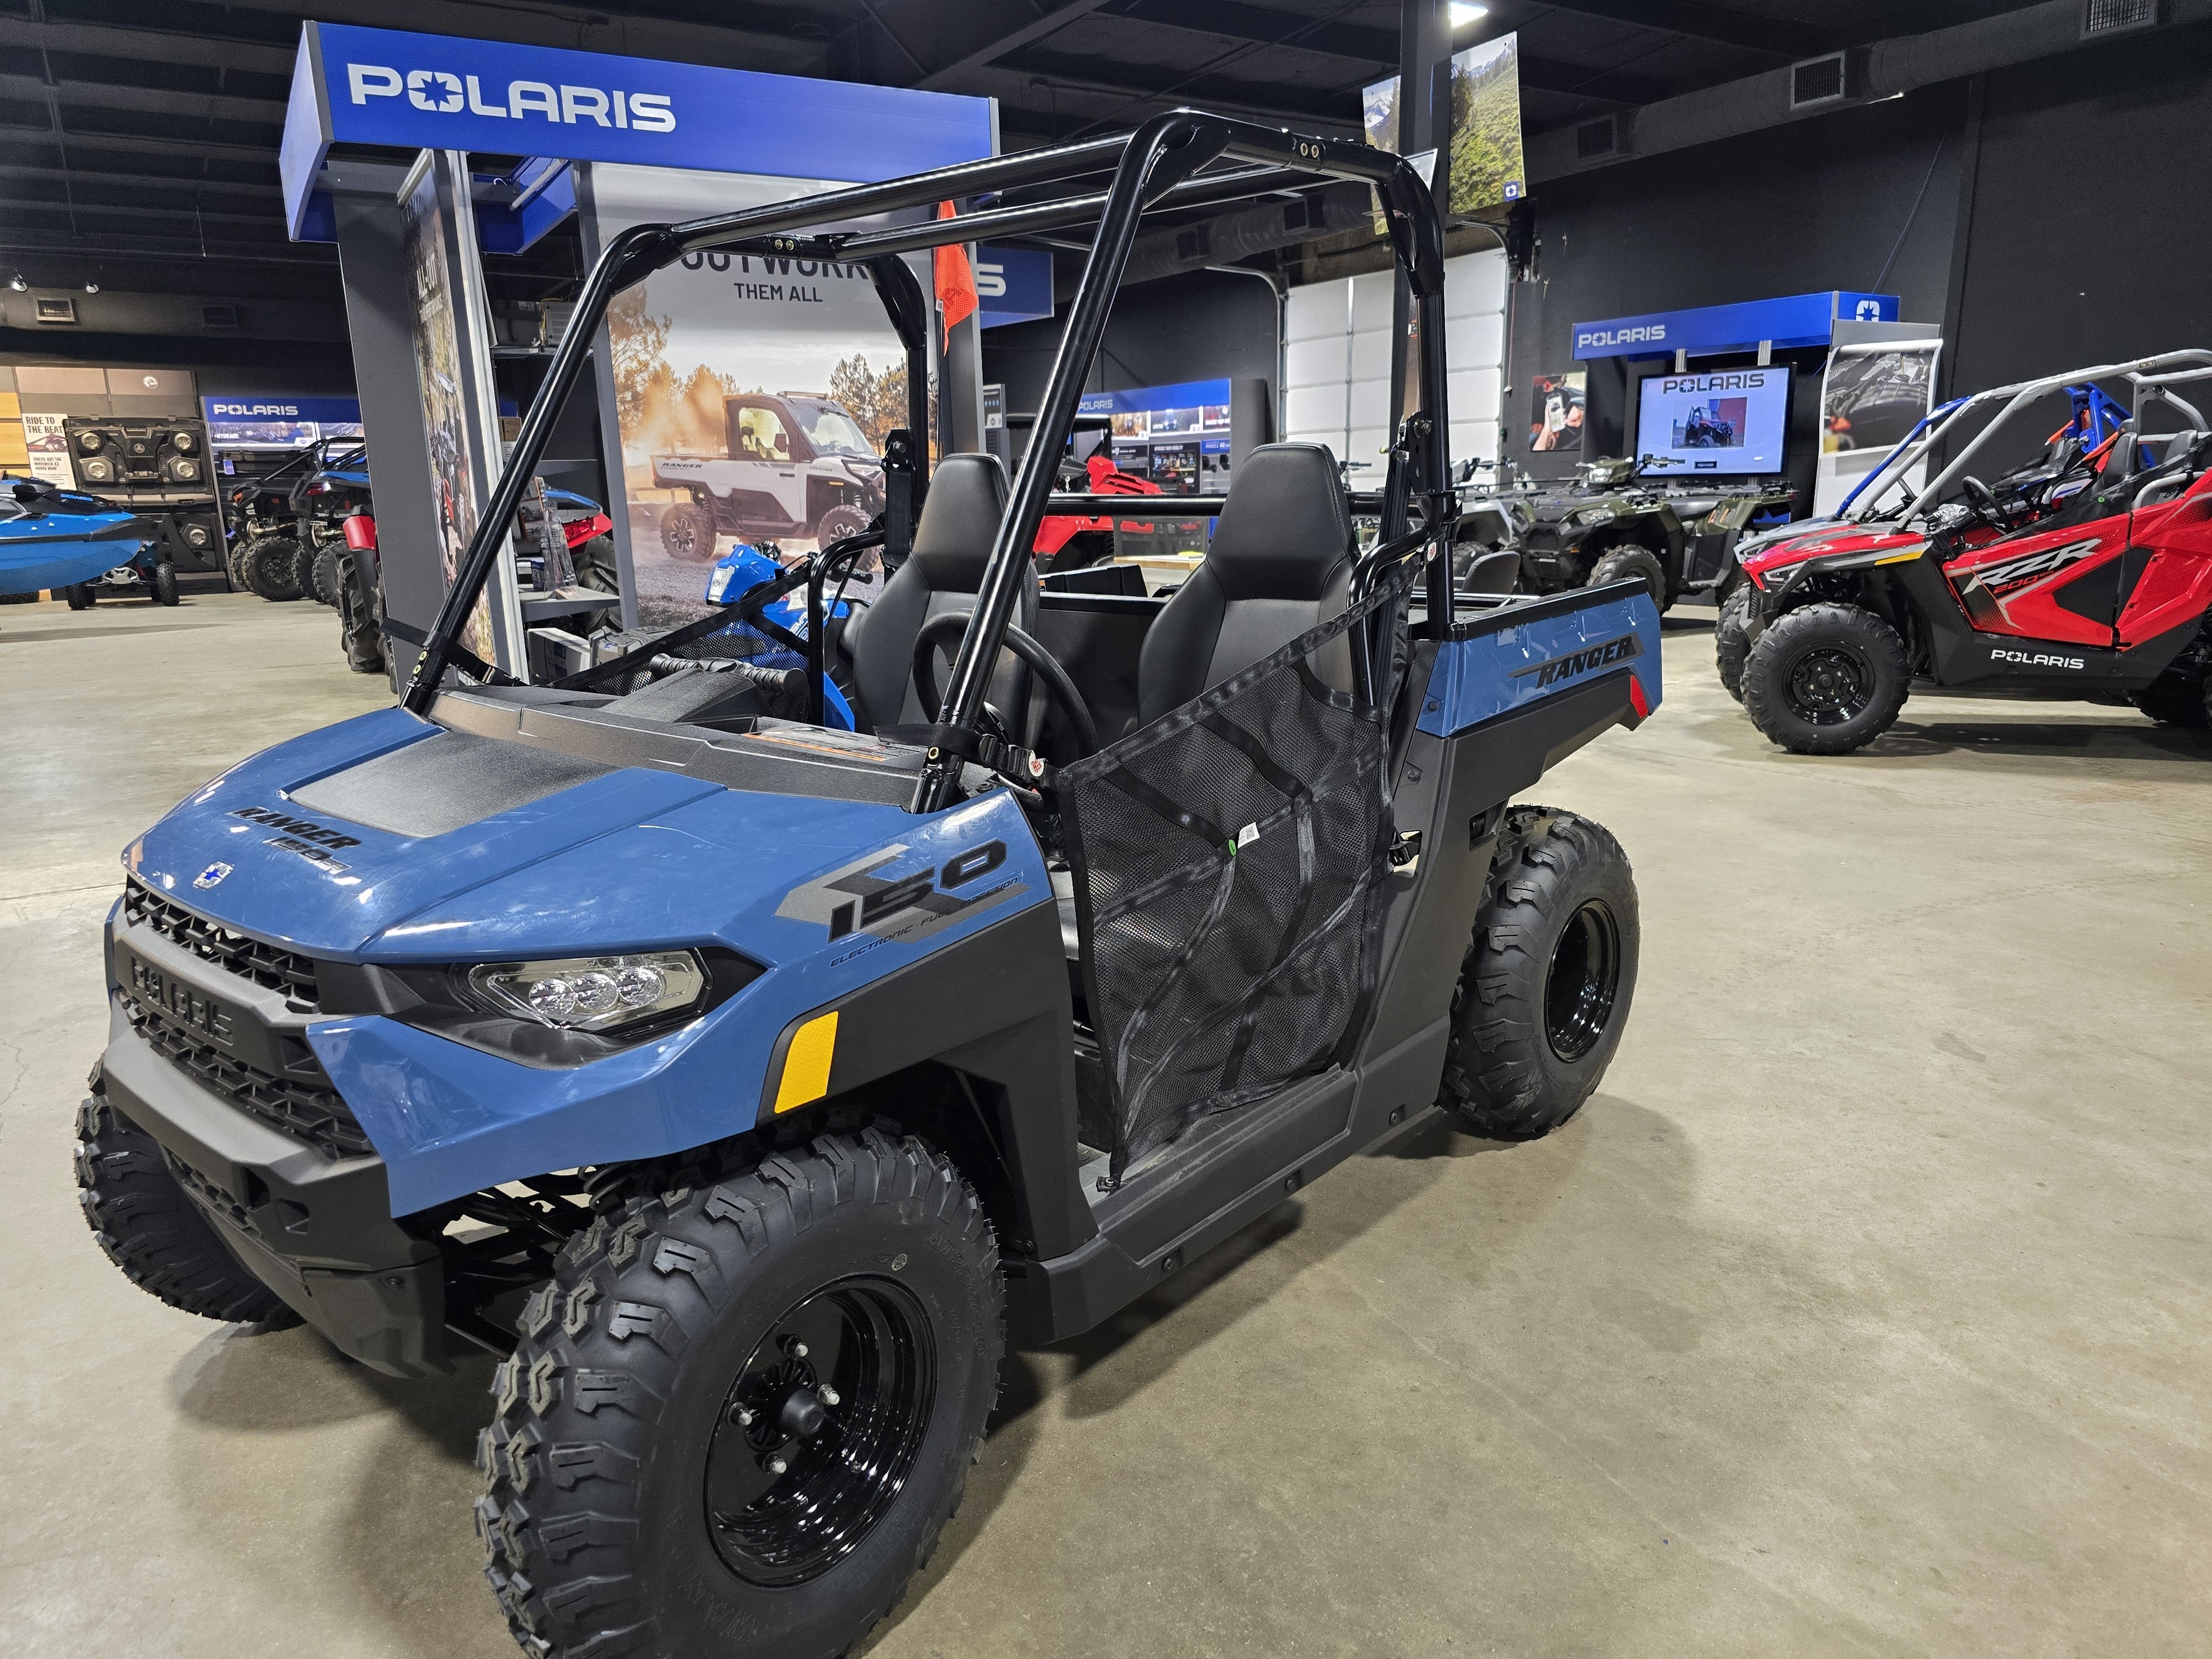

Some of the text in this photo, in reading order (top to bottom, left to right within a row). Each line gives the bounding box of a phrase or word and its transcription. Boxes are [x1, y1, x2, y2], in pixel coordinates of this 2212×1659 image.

[347, 63, 676, 133] POLARIS
[734, 283, 823, 302] THEM ALL
[1578, 325, 1666, 348] POLARIS
[1662, 373, 1765, 394] POLARIS
[25, 416, 55, 425] RIDE TO
[213, 404, 299, 415] POLARIS
[27, 425, 43, 434] THE
[1962, 538, 2102, 594] RZR
[1993, 576, 2039, 594] 200
[1536, 636, 1632, 690] RANGER
[1991, 649, 2084, 669] POLARIS
[229, 807, 362, 850] RANGER
[828, 837, 1008, 944] 150
[830, 877, 1019, 968] ELECTRONIC FUEL INJECTION
